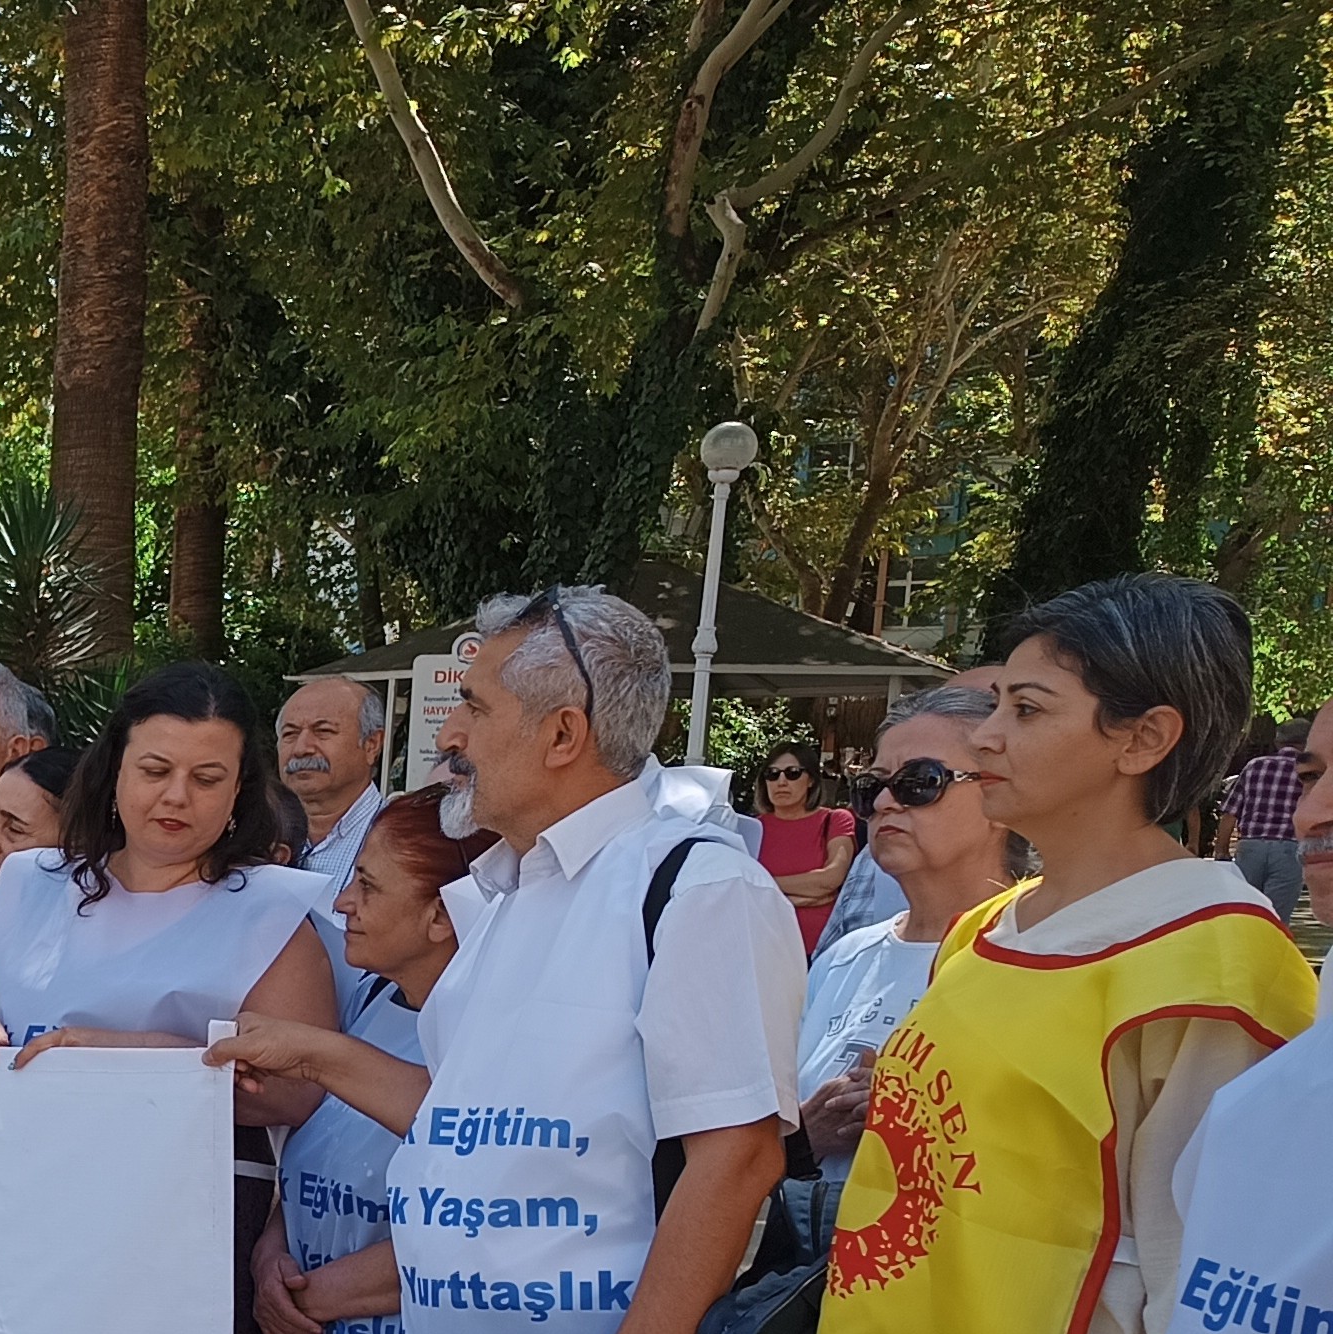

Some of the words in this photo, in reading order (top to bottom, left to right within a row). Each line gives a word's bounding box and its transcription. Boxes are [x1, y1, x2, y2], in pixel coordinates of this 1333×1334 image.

[434, 667, 466, 684] DİK
[423, 706, 457, 716] HAYVA
[428, 1106, 590, 1157] Eğitim,
[927, 1069, 982, 1194] SEN
[418, 1187, 598, 1238] Yaşam,
[401, 1265, 635, 1322] Yurttaşlık
